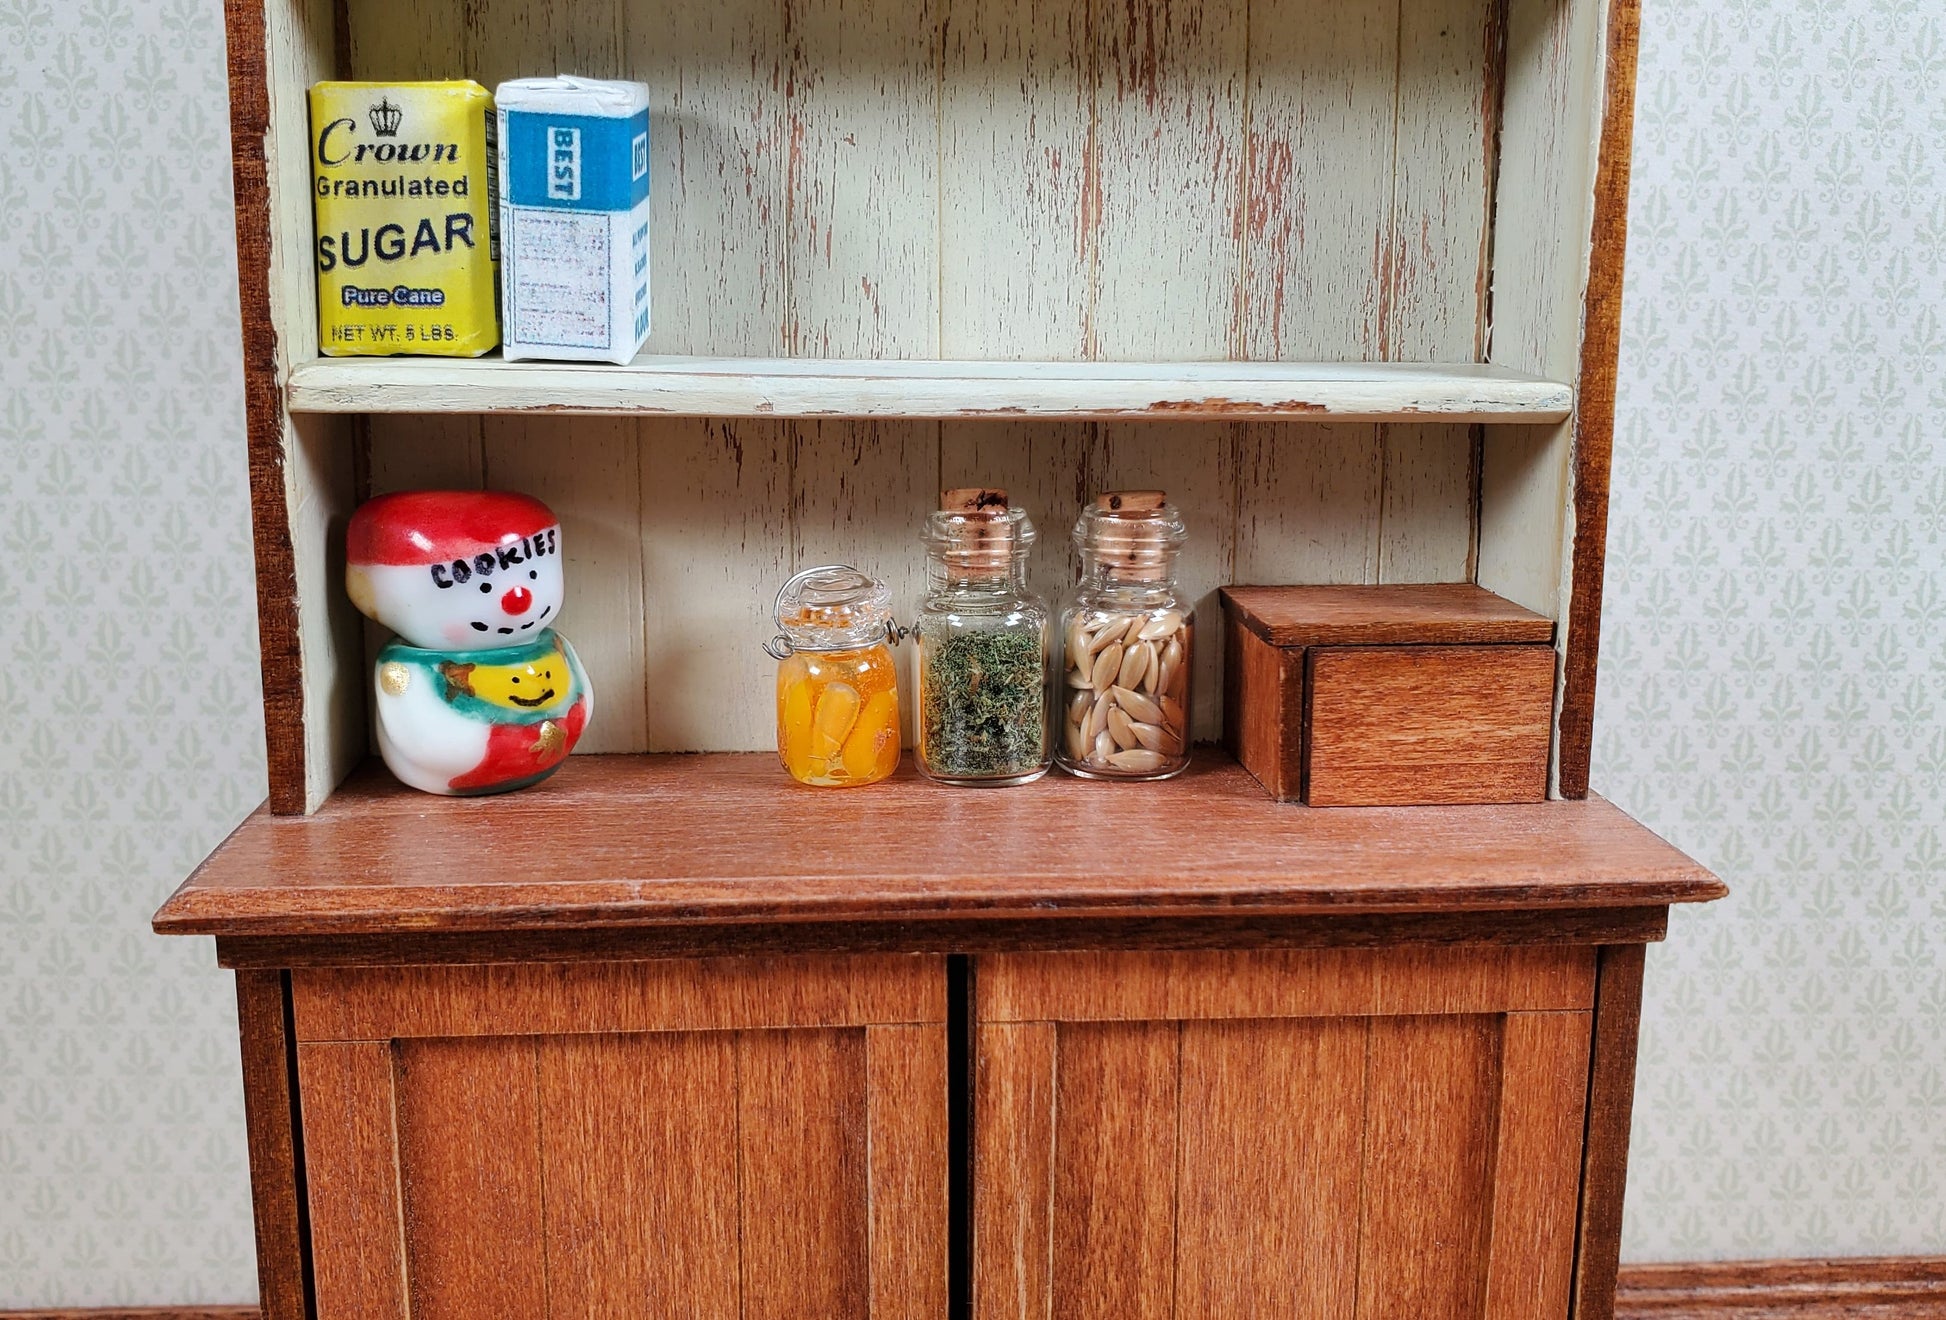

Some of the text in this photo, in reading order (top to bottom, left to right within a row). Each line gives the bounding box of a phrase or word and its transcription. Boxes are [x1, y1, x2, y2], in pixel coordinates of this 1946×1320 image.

[318, 118, 460, 168] Crown
[554, 128, 575, 197] BEST
[317, 175, 469, 198] Granulated
[319, 213, 476, 272] SUGAR
[343, 286, 444, 305] Pure Cane
[331, 325, 459, 342] NET WT. 5 LBS.
[430, 529, 556, 589] COOKIES
